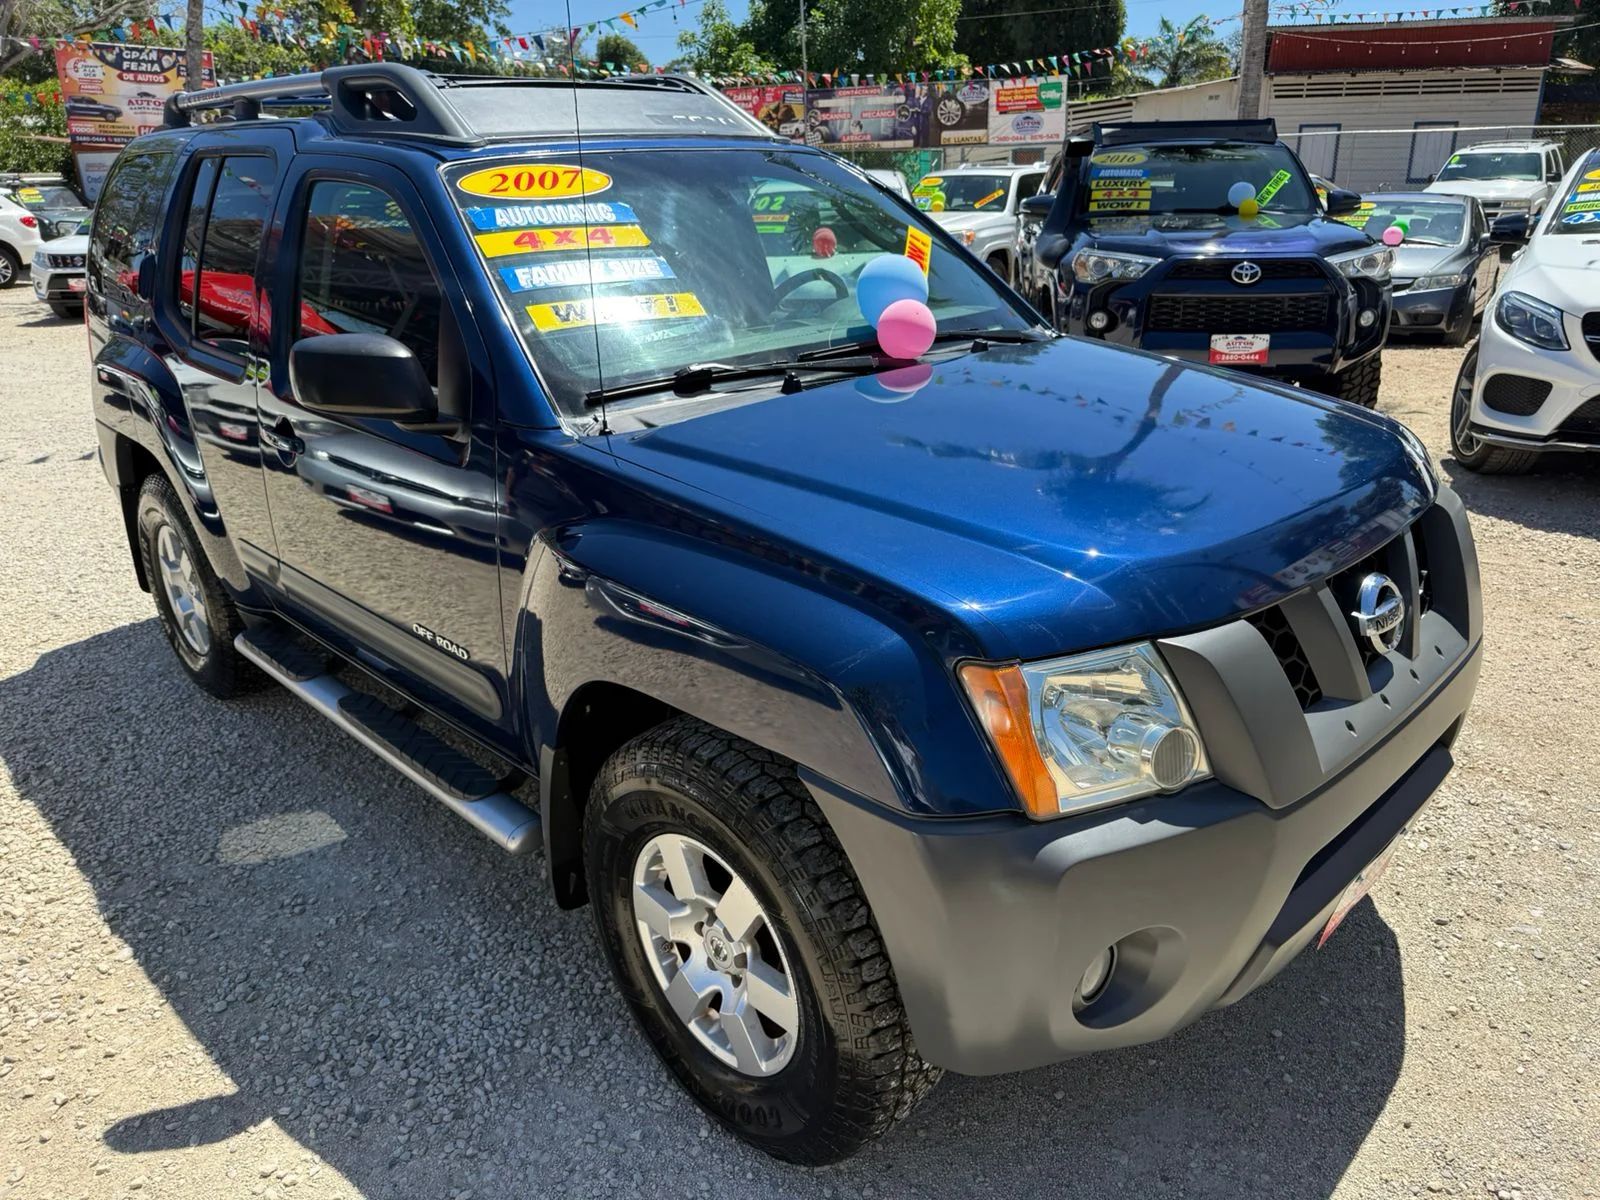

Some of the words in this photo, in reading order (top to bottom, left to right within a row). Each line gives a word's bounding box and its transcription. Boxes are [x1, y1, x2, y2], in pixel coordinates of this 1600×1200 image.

[122, 61, 161, 72] FERIA
[137, 73, 165, 82] AUTOS
[1101, 154, 1136, 163] 2016
[1099, 169, 1144, 177] AUTOMATIC
[489, 168, 582, 193] 2007
[1095, 180, 1145, 188] LUXURY
[1256, 187, 1272, 206] NEW
[1268, 171, 1289, 190] TIRES
[495, 203, 617, 227] AUTOMATIC
[412, 623, 434, 641] OFF
[436, 634, 469, 660] ROAD
